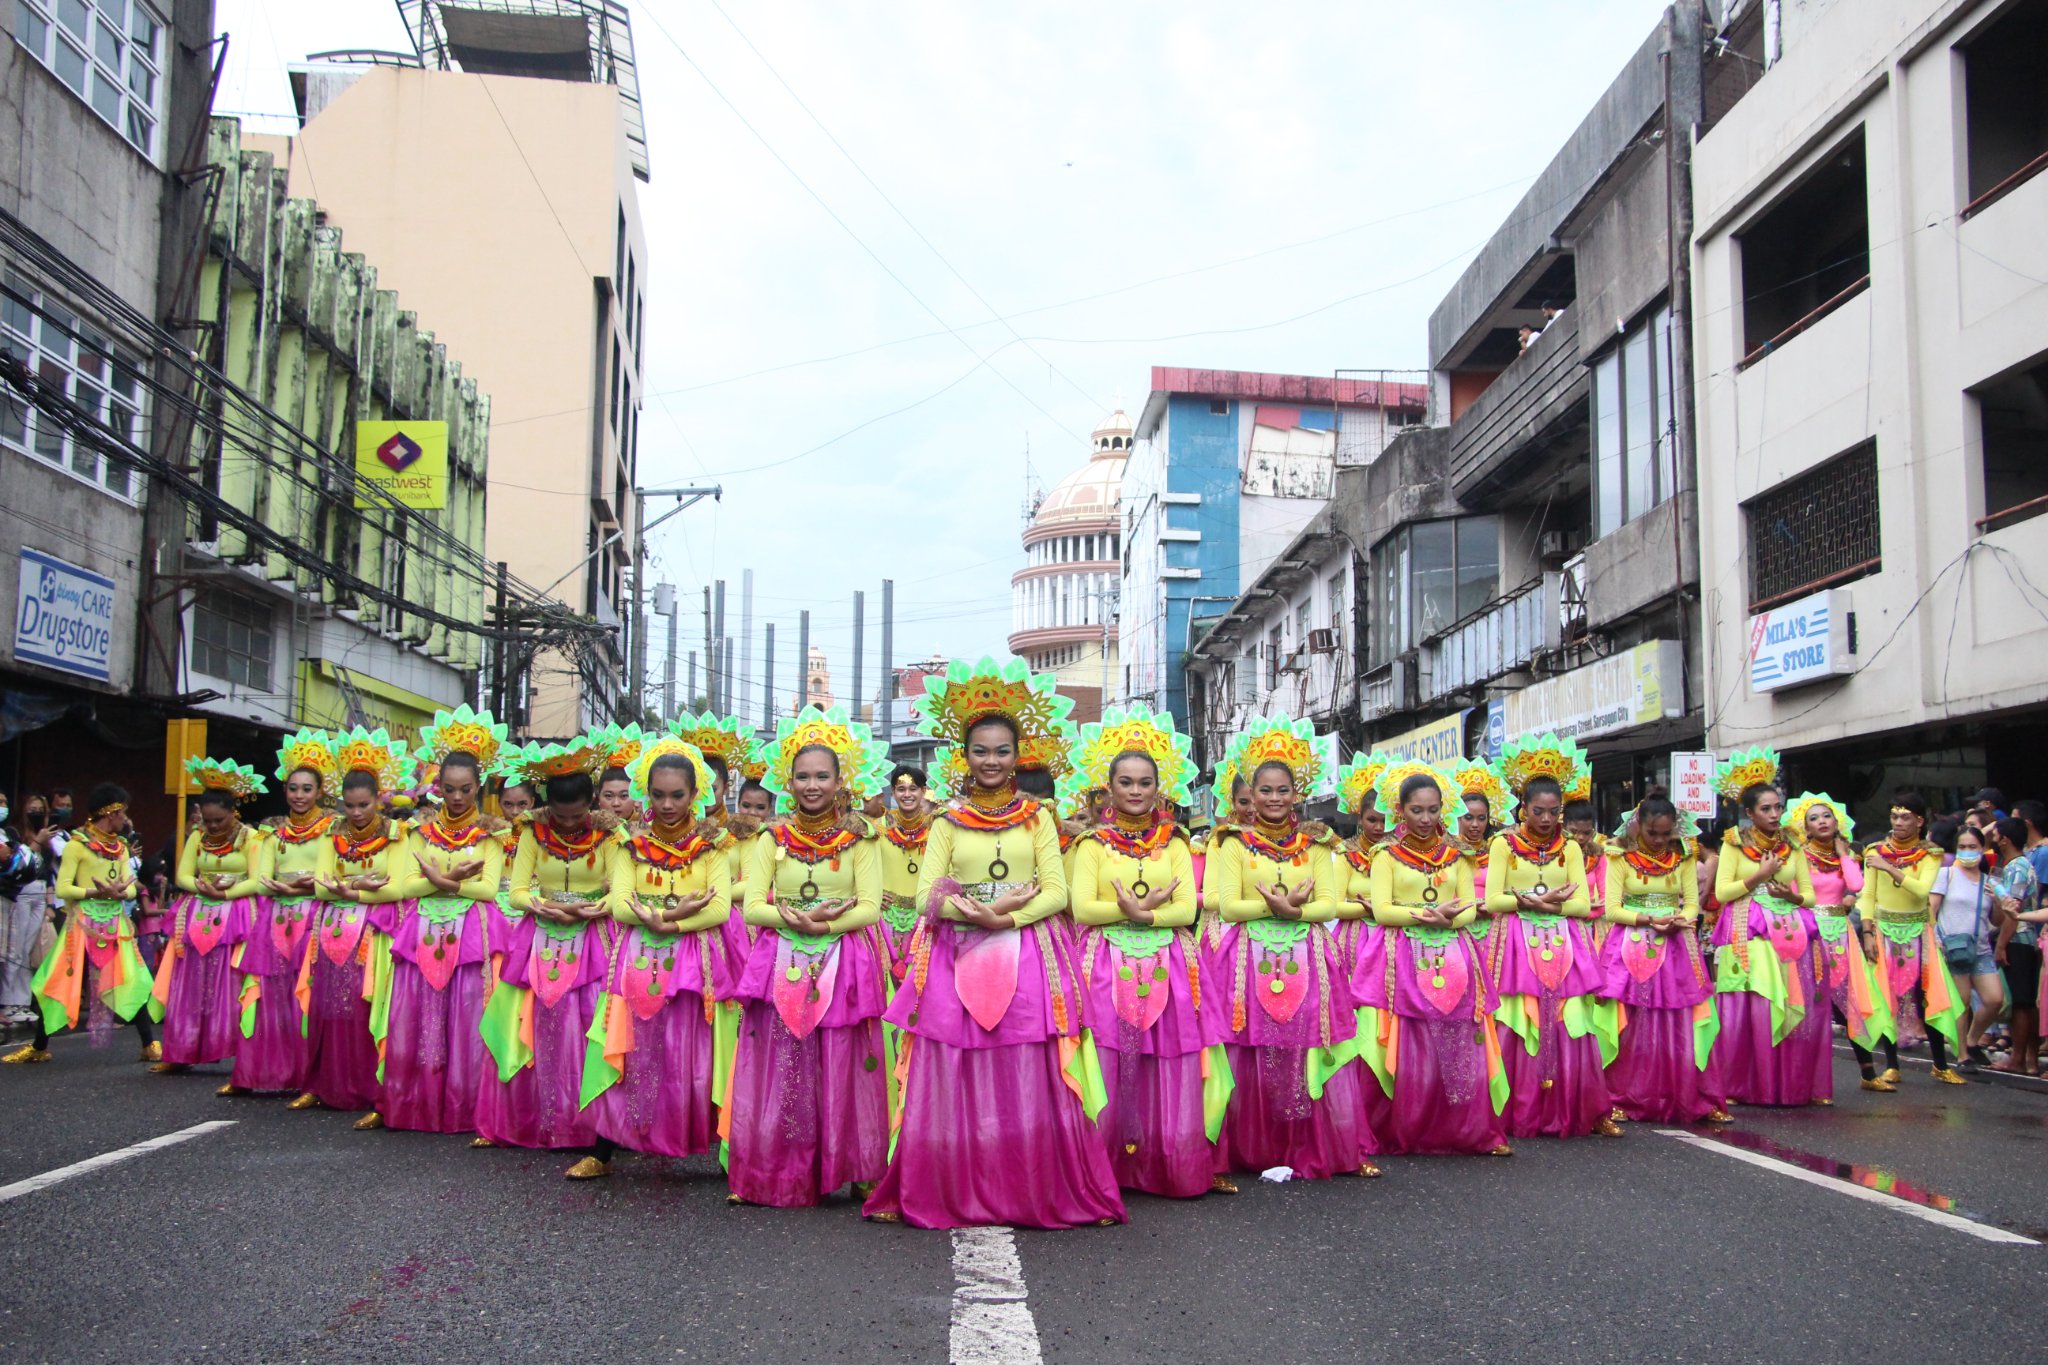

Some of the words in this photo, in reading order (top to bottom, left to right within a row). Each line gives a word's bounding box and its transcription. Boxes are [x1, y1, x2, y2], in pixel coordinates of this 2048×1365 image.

[82, 589, 112, 619] CARE
[20, 594, 110, 656] Drugstore
[1765, 616, 1807, 646] MILA'S
[1783, 644, 1825, 672] STORE
[1617, 706, 1628, 721] City
[1420, 727, 1458, 765] CENTER
[1689, 760, 1698, 770] NO
[1680, 772, 1706, 785] LOADING
[1687, 787, 1699, 798] AND
[1676, 801, 1710, 812] UNLOADING
